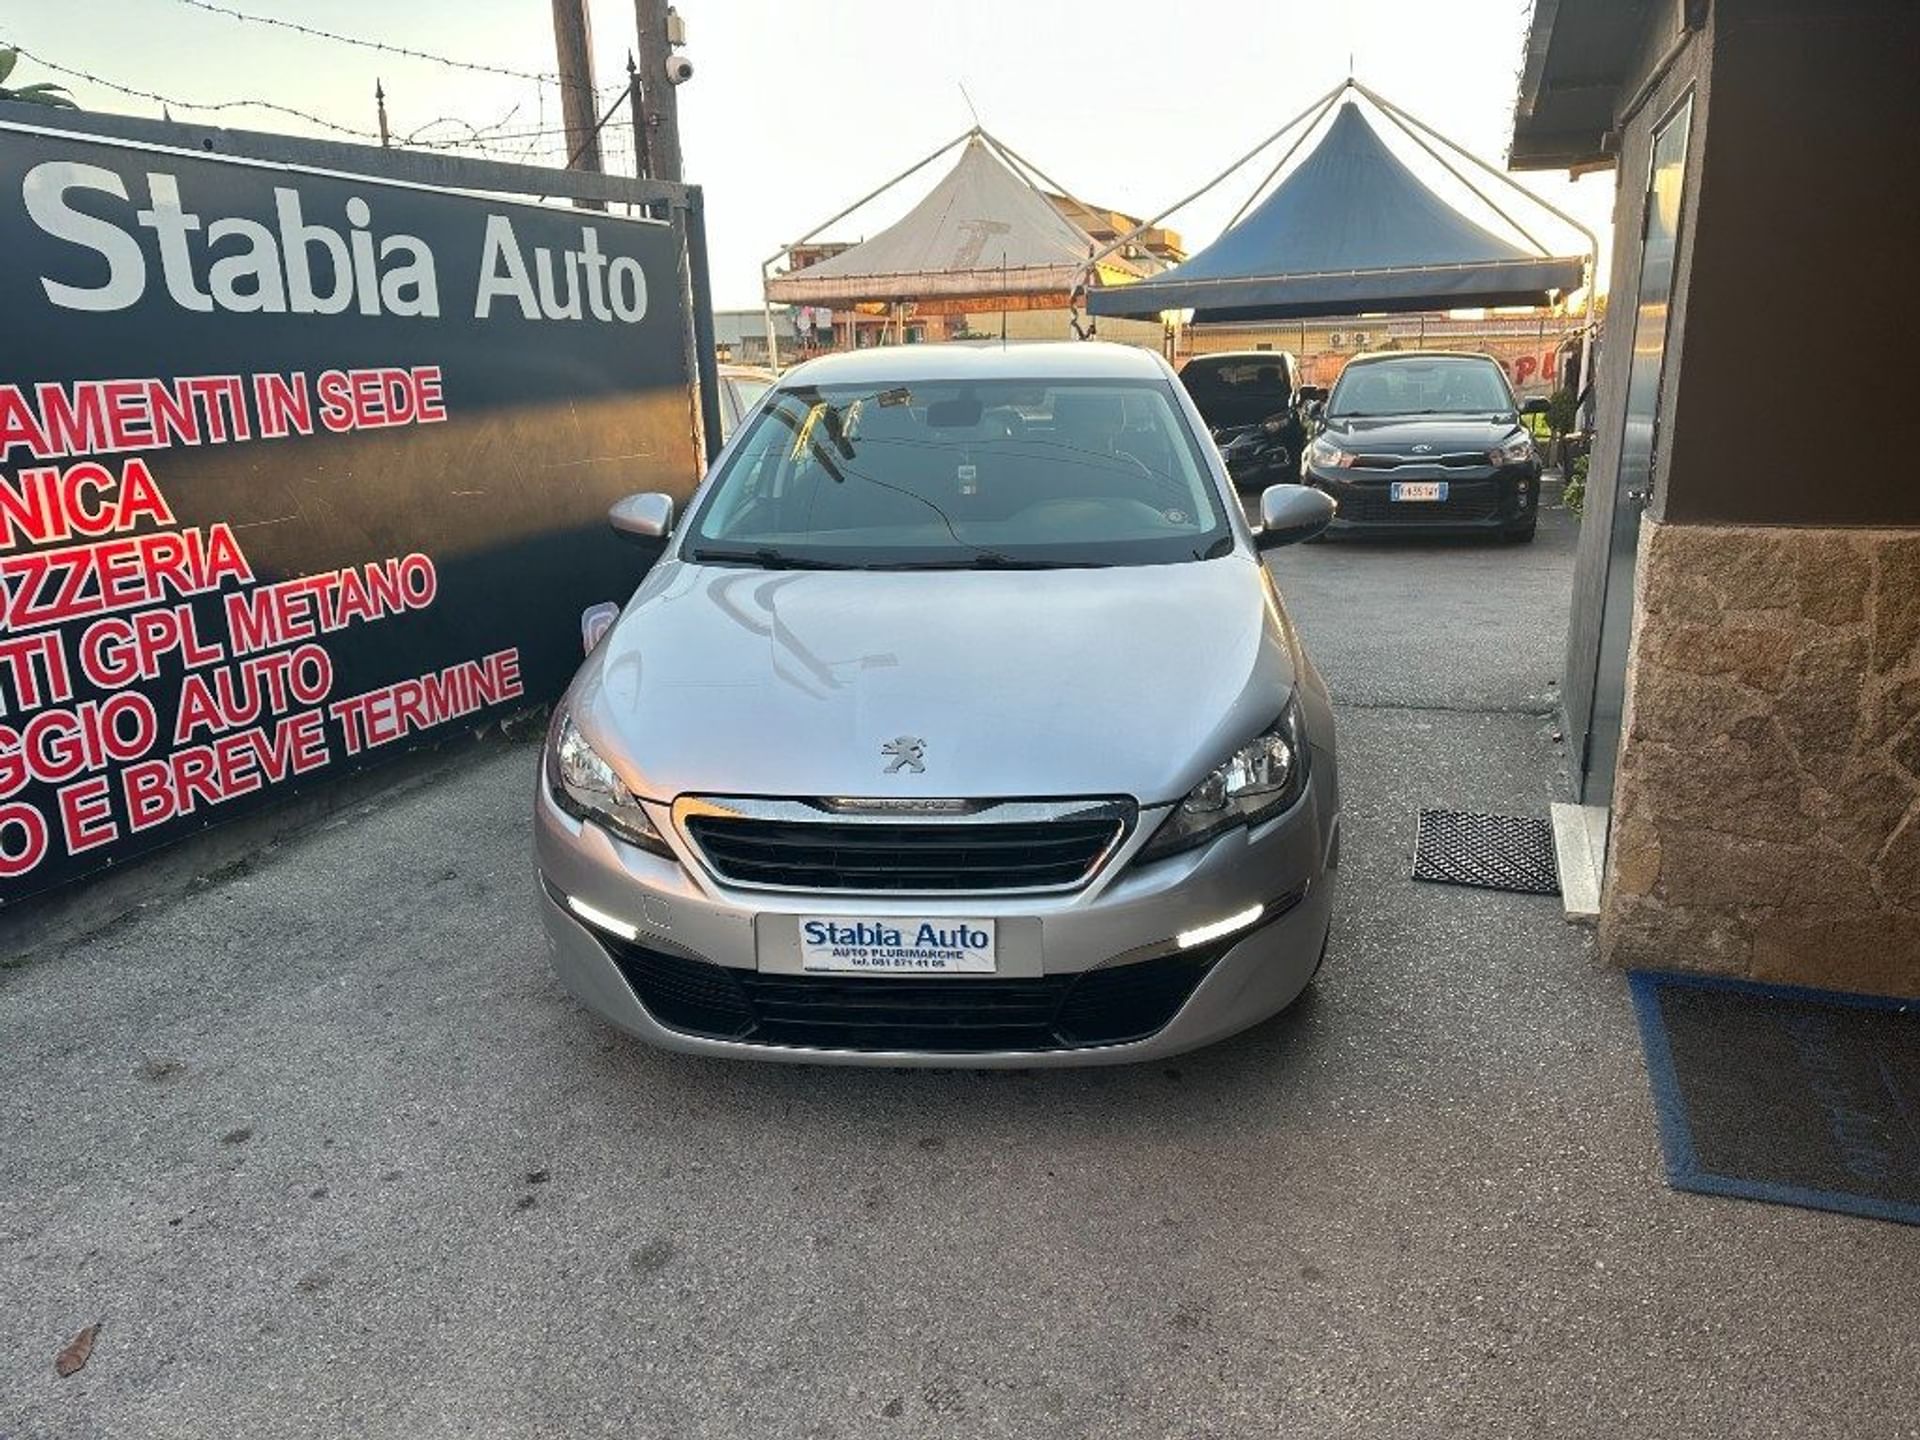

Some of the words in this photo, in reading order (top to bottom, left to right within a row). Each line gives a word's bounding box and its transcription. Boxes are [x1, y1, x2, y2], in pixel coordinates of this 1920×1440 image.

[22, 160, 440, 318] Stabia
[474, 213, 646, 324] Auto
[0, 375, 250, 461] AMENTI
[253, 371, 313, 437] IN
[317, 366, 448, 432] SEDE
[0, 458, 176, 548] NICA
[0, 522, 256, 632] ZZERIA
[0, 630, 73, 716] TI
[79, 604, 224, 690] GPL
[224, 553, 438, 659] METANO
[173, 643, 333, 745] AUTO
[57, 775, 119, 856] E
[122, 712, 330, 833] BREVE
[330, 648, 524, 756] TERMINE
[804, 921, 901, 946] Stabia
[915, 923, 989, 948] Auto
[832, 948, 868, 957] AUTO
[871, 948, 964, 960] PLURIMARCHE
